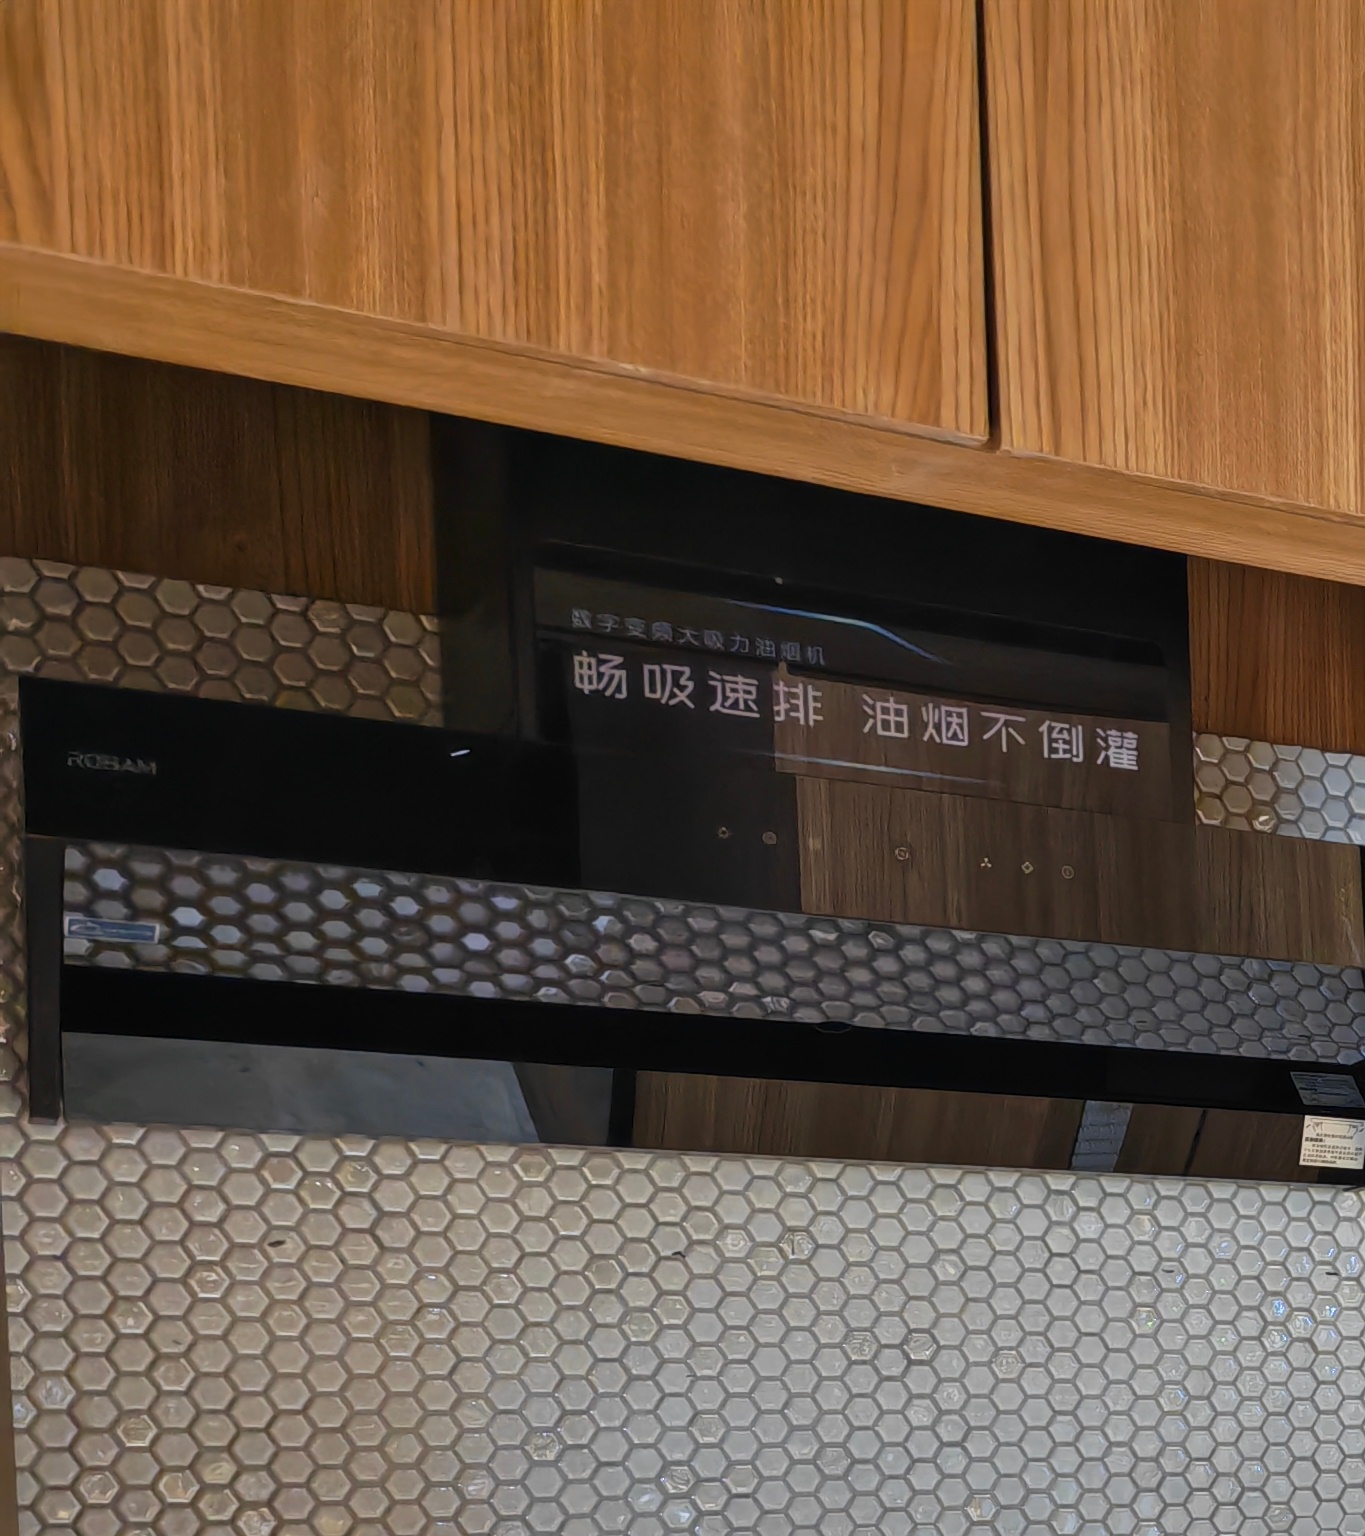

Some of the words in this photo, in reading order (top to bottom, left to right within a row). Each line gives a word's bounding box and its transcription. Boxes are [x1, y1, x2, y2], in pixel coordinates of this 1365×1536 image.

[571, 648, 825, 728] 畅吸速排
[861, 690, 1141, 772] 油烟不倒灌
